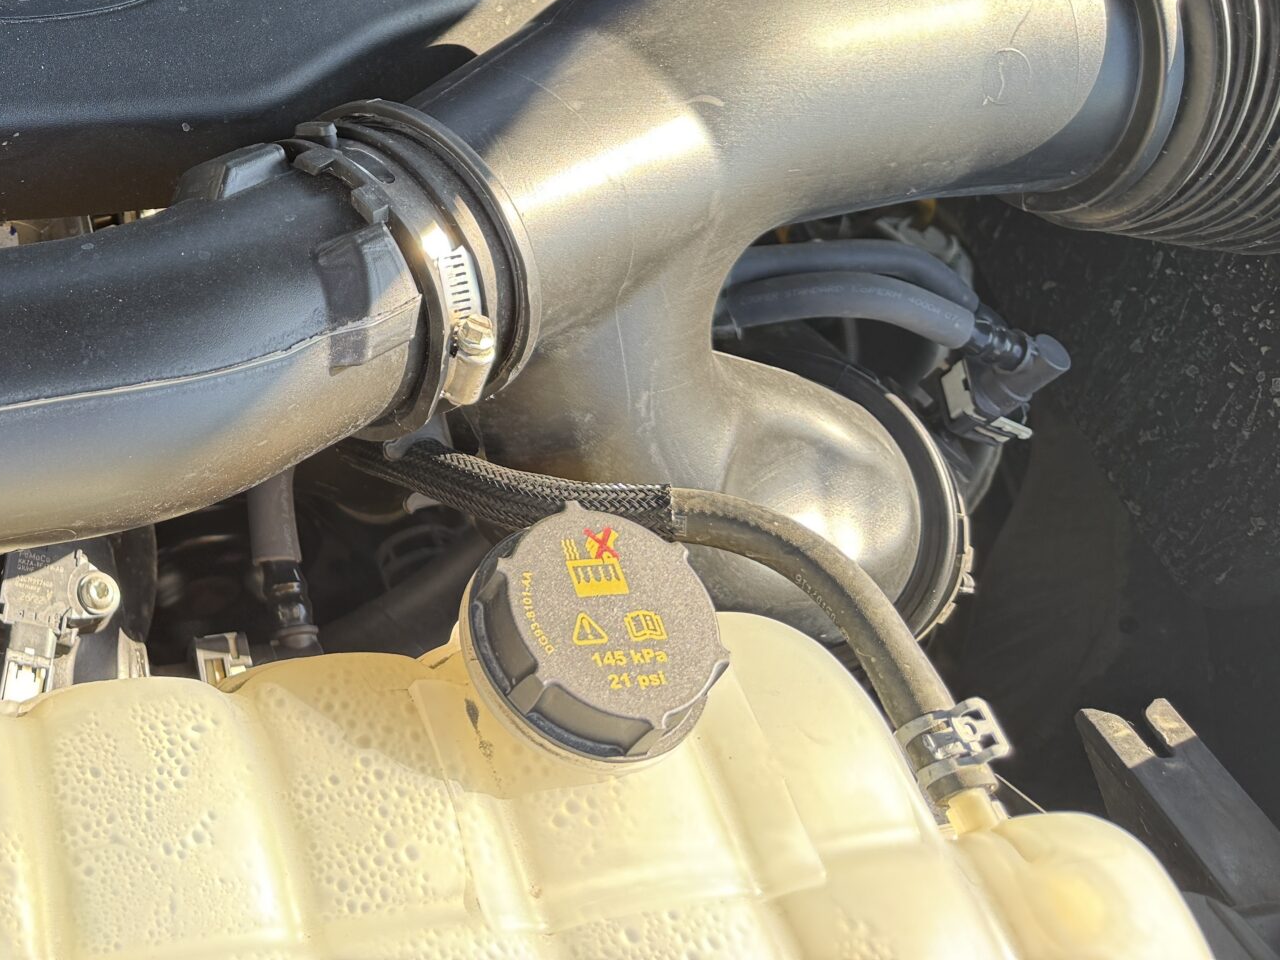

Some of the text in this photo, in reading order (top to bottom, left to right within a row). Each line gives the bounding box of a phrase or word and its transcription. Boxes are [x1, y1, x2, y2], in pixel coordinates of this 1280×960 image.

[592, 648, 668, 667] 145 kPa
[607, 670, 668, 690] 21 psi
